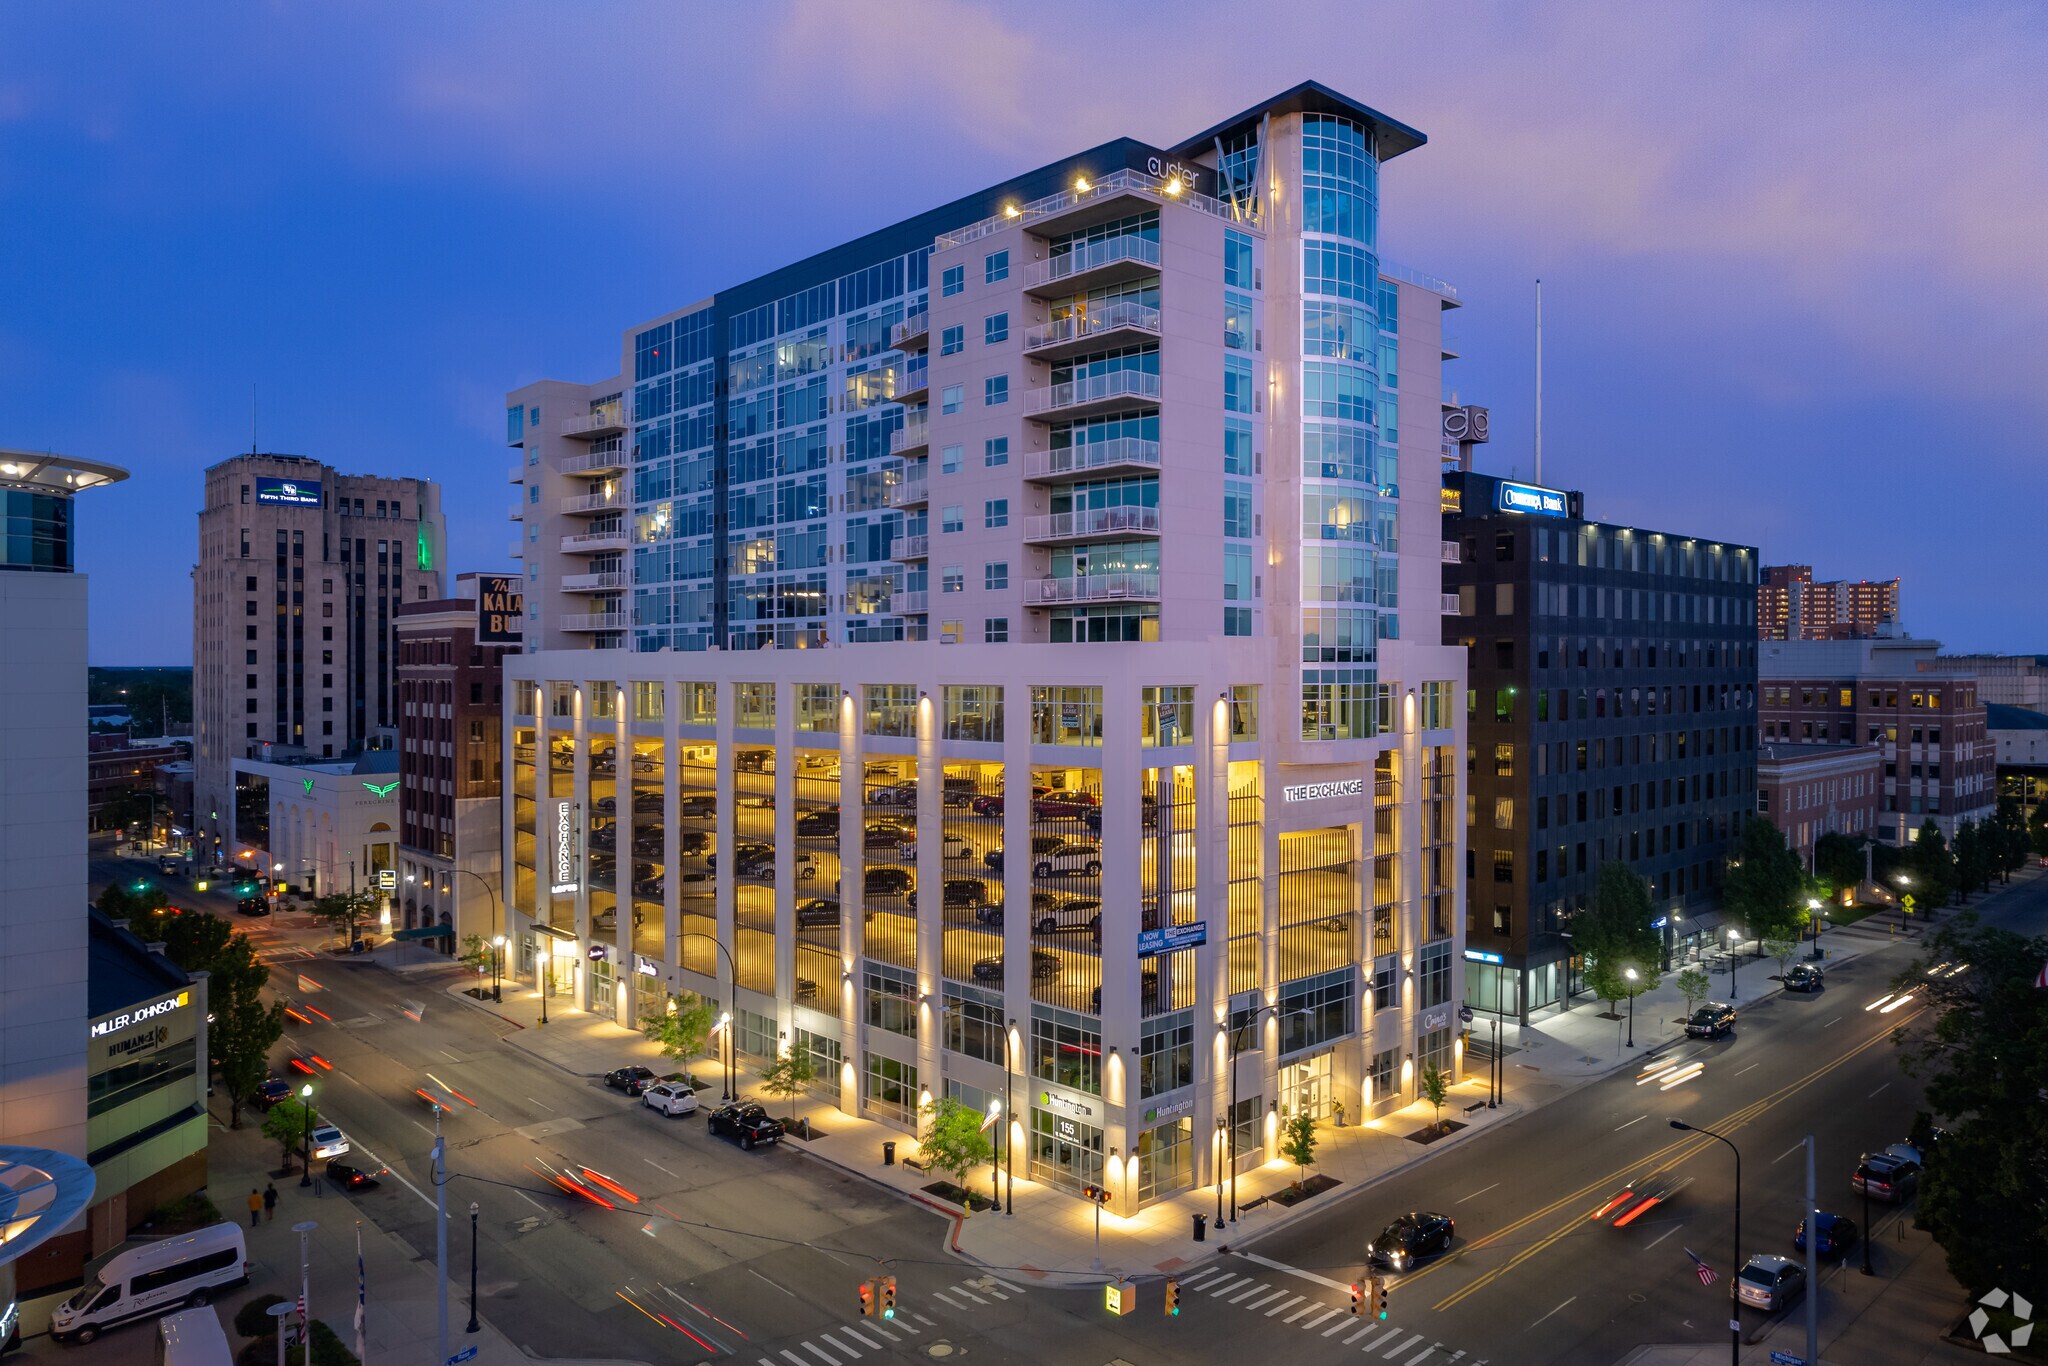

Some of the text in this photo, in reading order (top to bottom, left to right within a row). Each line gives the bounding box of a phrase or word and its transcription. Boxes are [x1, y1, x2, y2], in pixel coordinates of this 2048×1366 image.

[1147, 156, 1200, 190] custer
[1543, 495, 1563, 512] Bank
[491, 578, 510, 592] Th
[1284, 780, 1363, 802] THE EXCHANGE
[559, 803, 571, 882] EXCHANGE
[1143, 931, 1160, 941] NOW
[1166, 929, 1177, 938] THE
[1177, 924, 1205, 936] EXCHANGE
[1139, 939, 1164, 951] LEASING
[91, 997, 180, 1038] MILLER JOHNSON
[1049, 1094, 1088, 1115] Huntington
[1156, 1099, 1193, 1119] Huntington
[1061, 1121, 1075, 1135] 155
[1774, 1352, 1803, 1366] Michigan
